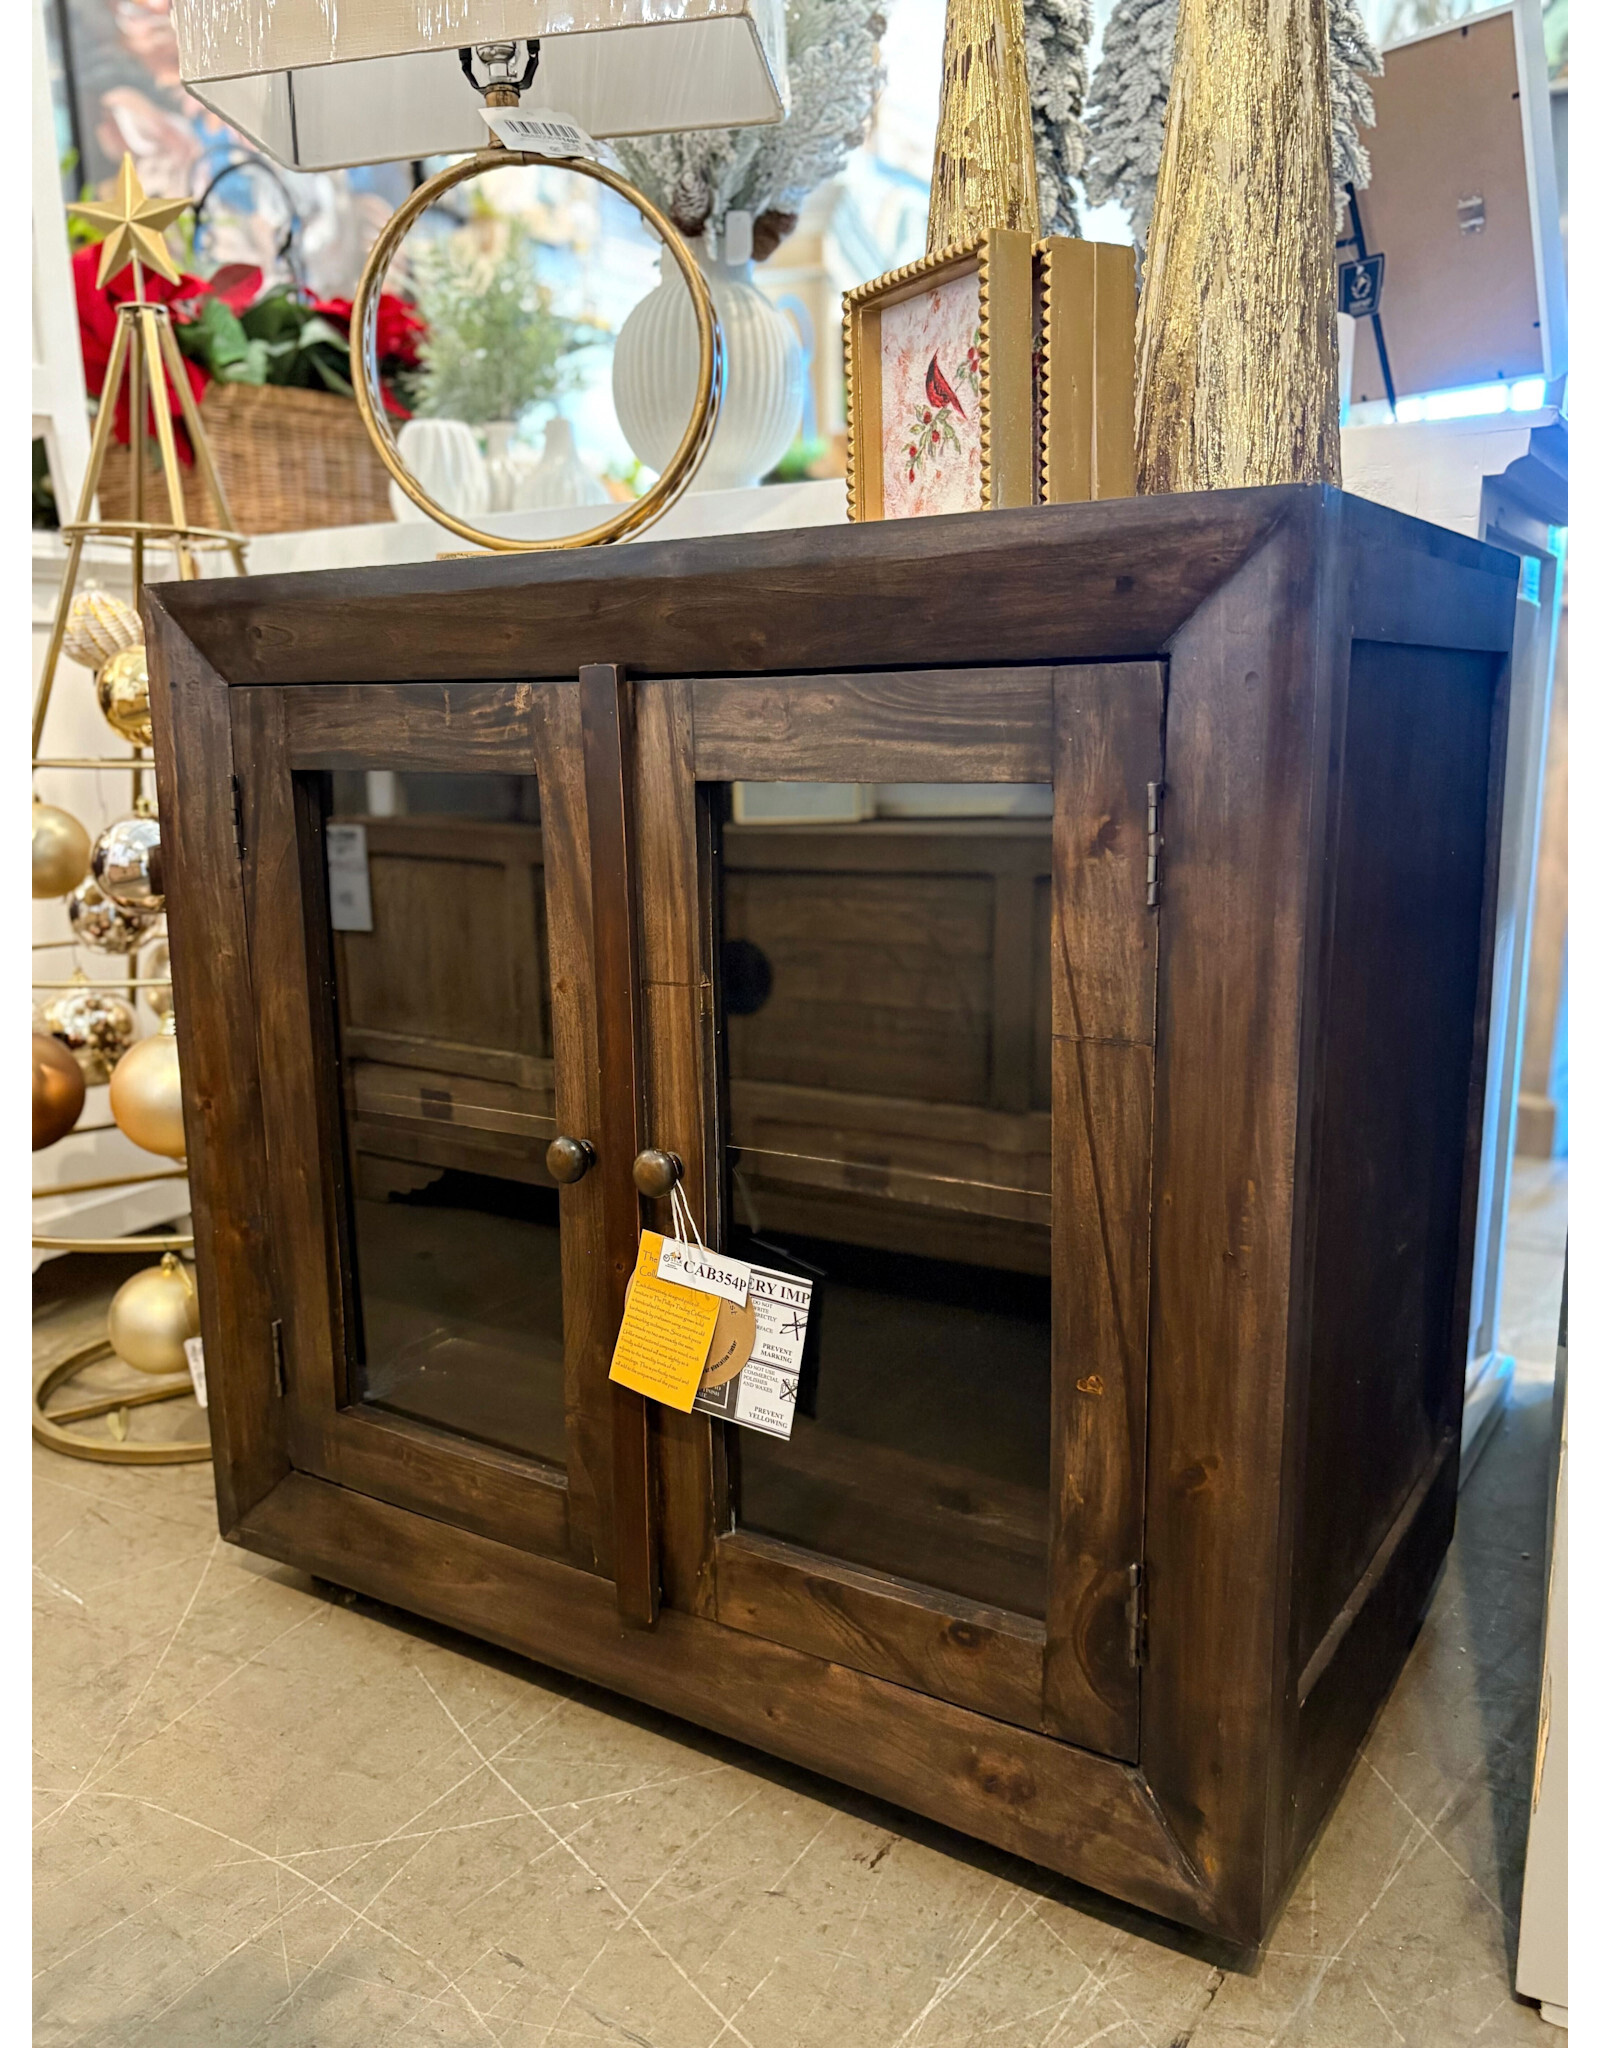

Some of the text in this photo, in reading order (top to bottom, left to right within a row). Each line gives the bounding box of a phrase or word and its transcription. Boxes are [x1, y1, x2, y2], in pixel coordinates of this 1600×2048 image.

[643, 1250, 659, 1263] The
[683, 1260, 747, 1293] CAB354P
[749, 1277, 810, 1304] ERY IMP
[754, 1312, 777, 1322] IRECTLY
[756, 1325, 772, 1333] RFACE
[763, 1343, 792, 1356] PREVENT
[761, 1350, 792, 1363] MARKING
[744, 1369, 778, 1383] COMMERCIAL
[744, 1375, 767, 1385] POLISHES
[755, 1384, 772, 1393] WAXES
[755, 1406, 783, 1419] PREVENT
[749, 1412, 787, 1428] YELLOWING
